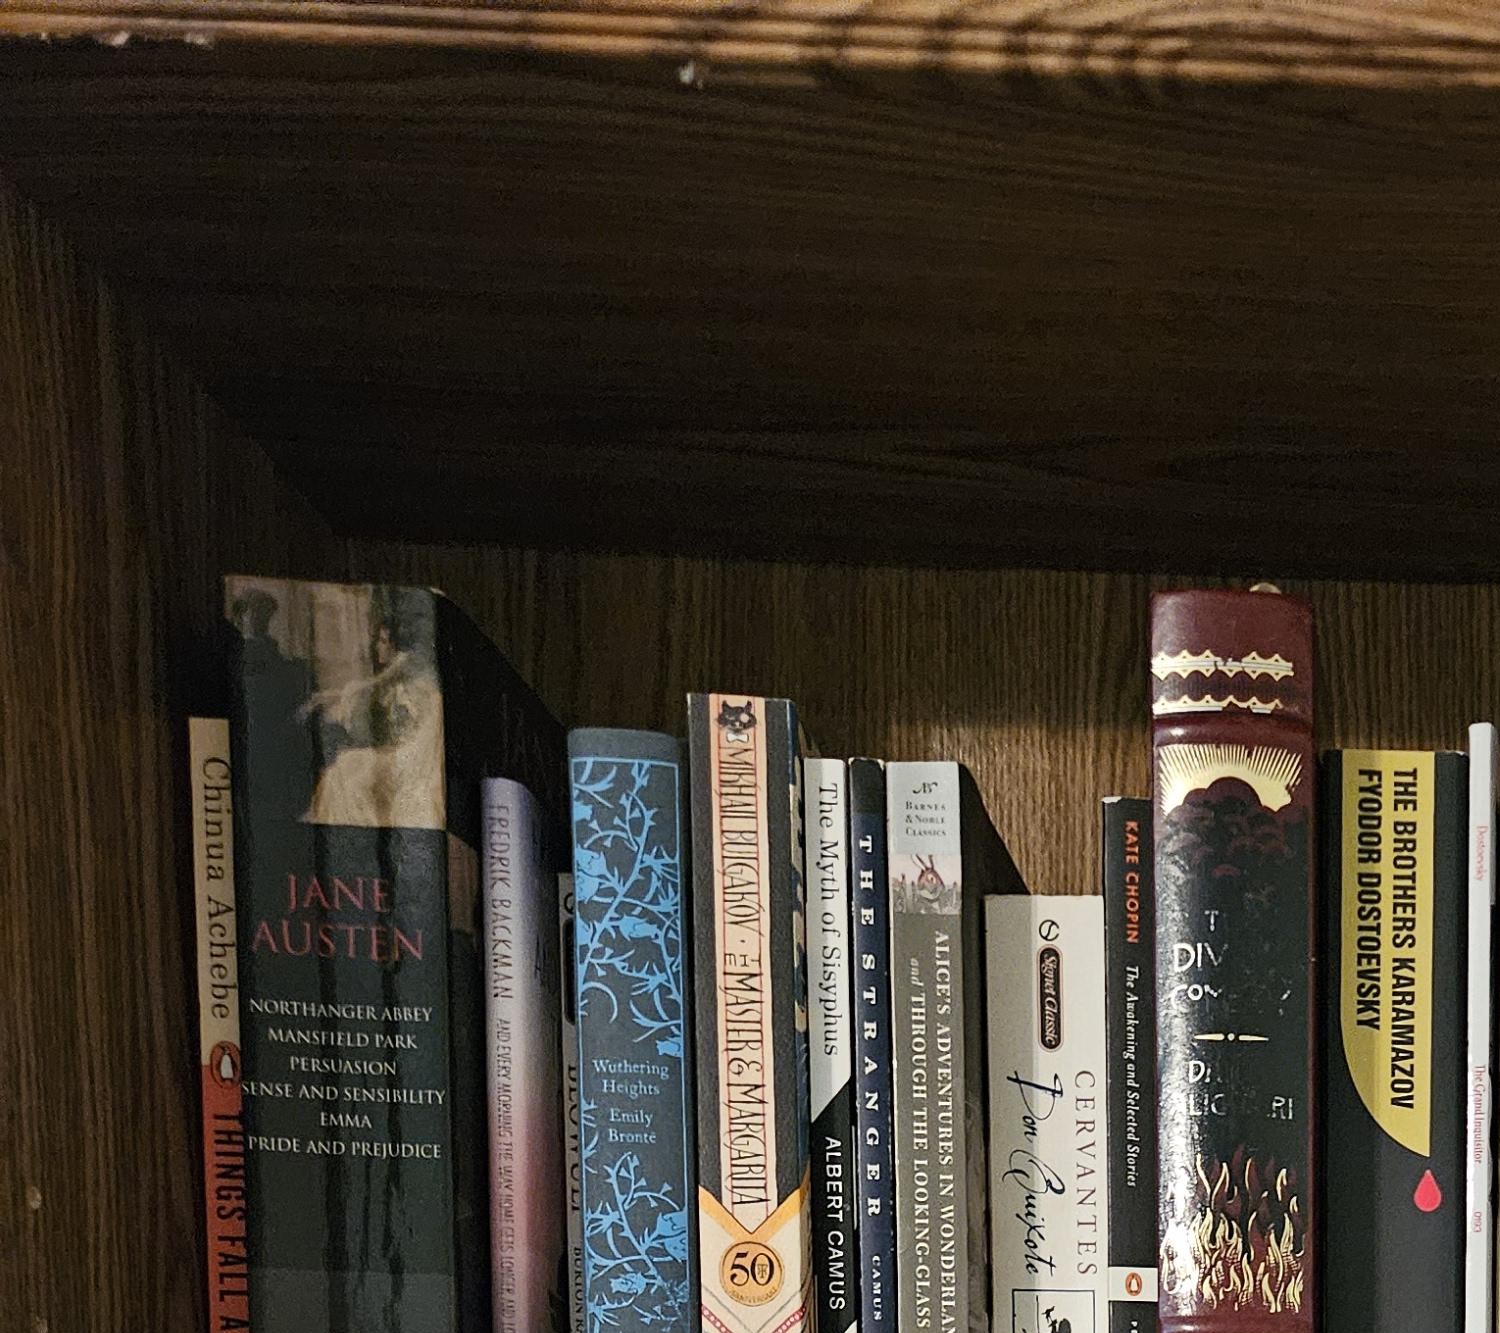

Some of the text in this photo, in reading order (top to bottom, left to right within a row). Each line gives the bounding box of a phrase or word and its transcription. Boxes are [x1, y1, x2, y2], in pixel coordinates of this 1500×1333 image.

[203, 757, 236, 1020] Chinua Achebe
[289, 874, 390, 912] JANE
[817, 783, 843, 1056] The Myth of Sisyphus
[1356, 769, 1382, 1030] FYODOR DOSTOEVSKY
[252, 920, 423, 961] AUSTEN
[1390, 768, 1419, 1109] THE BROTHERS KARAMAZOV
[250, 999, 432, 1022] NORTHANGER ABBEY
[290, 1057, 396, 1076] PERSUASION
[592, 1059, 669, 1080] Wuthering
[602, 1079, 660, 1099] Heights
[859, 836, 884, 1321] THE STRANGER CAMUS
[320, 1112, 372, 1128] EMMA
[610, 1108, 653, 1127] Emily
[212, 1111, 245, 1220] THINGS
[1004, 1069, 1065, 1275] Don Quixote
[1074, 1070, 1098, 1276] CERVANTES
[825, 1137, 847, 1310] ALBERT CAMUS
[217, 1236, 248, 1303] FALL
